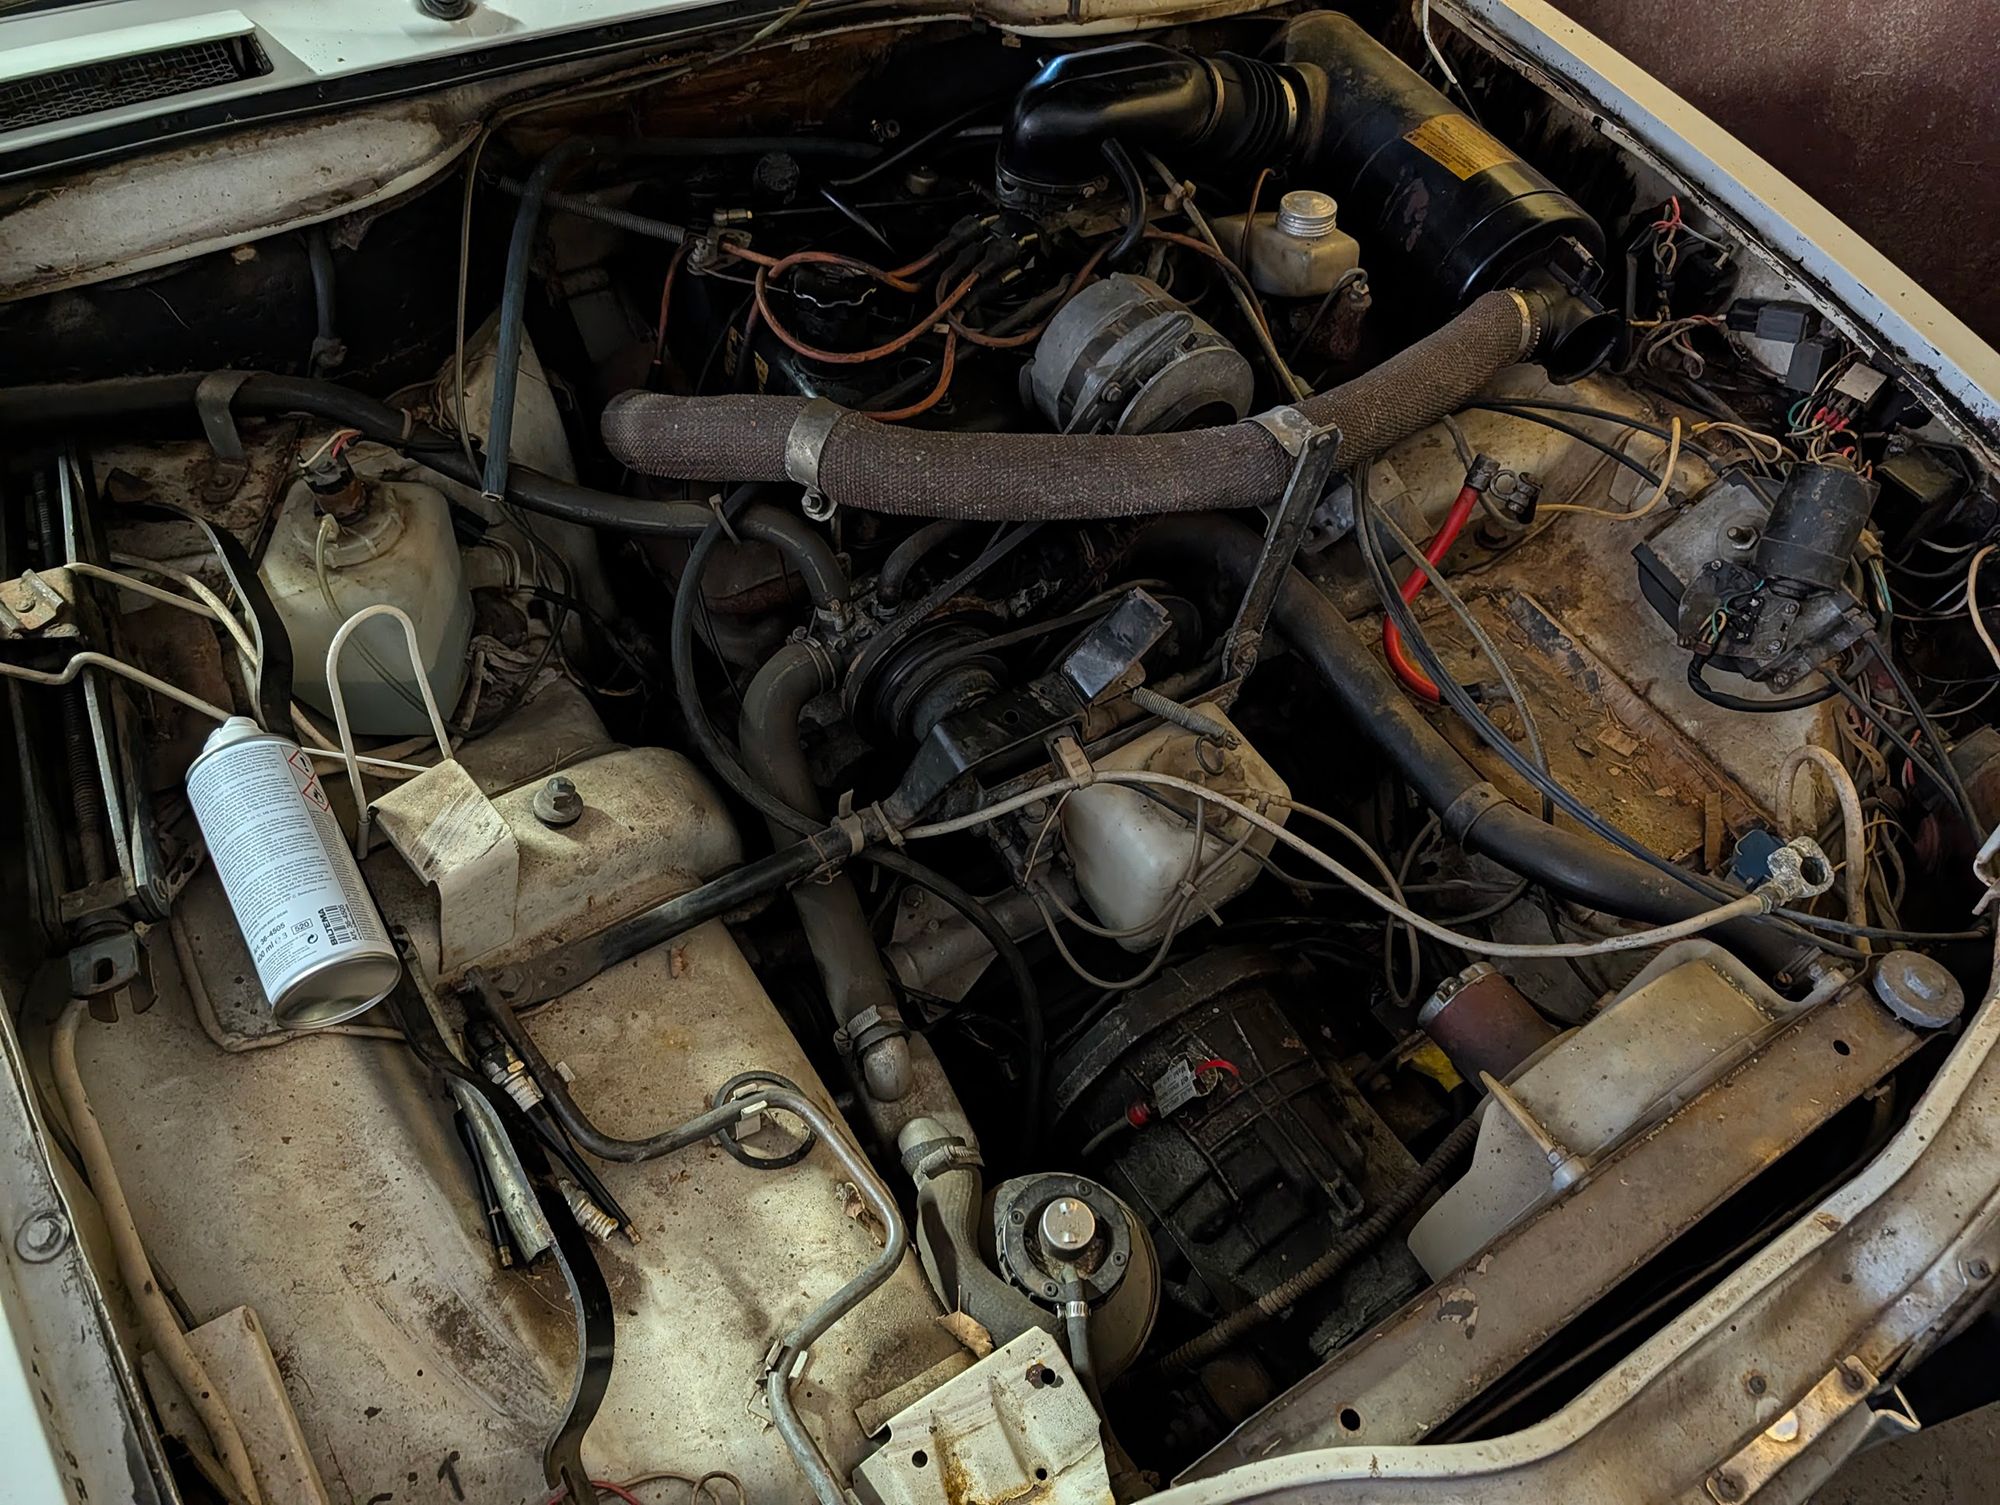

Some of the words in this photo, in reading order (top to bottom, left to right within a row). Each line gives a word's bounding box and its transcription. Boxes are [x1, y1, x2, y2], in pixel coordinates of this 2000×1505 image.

[260, 922, 286, 945] 36-4505
[294, 921, 310, 932] 520
[318, 908, 338, 946] BILTEMA
[265, 941, 275, 954] ml
